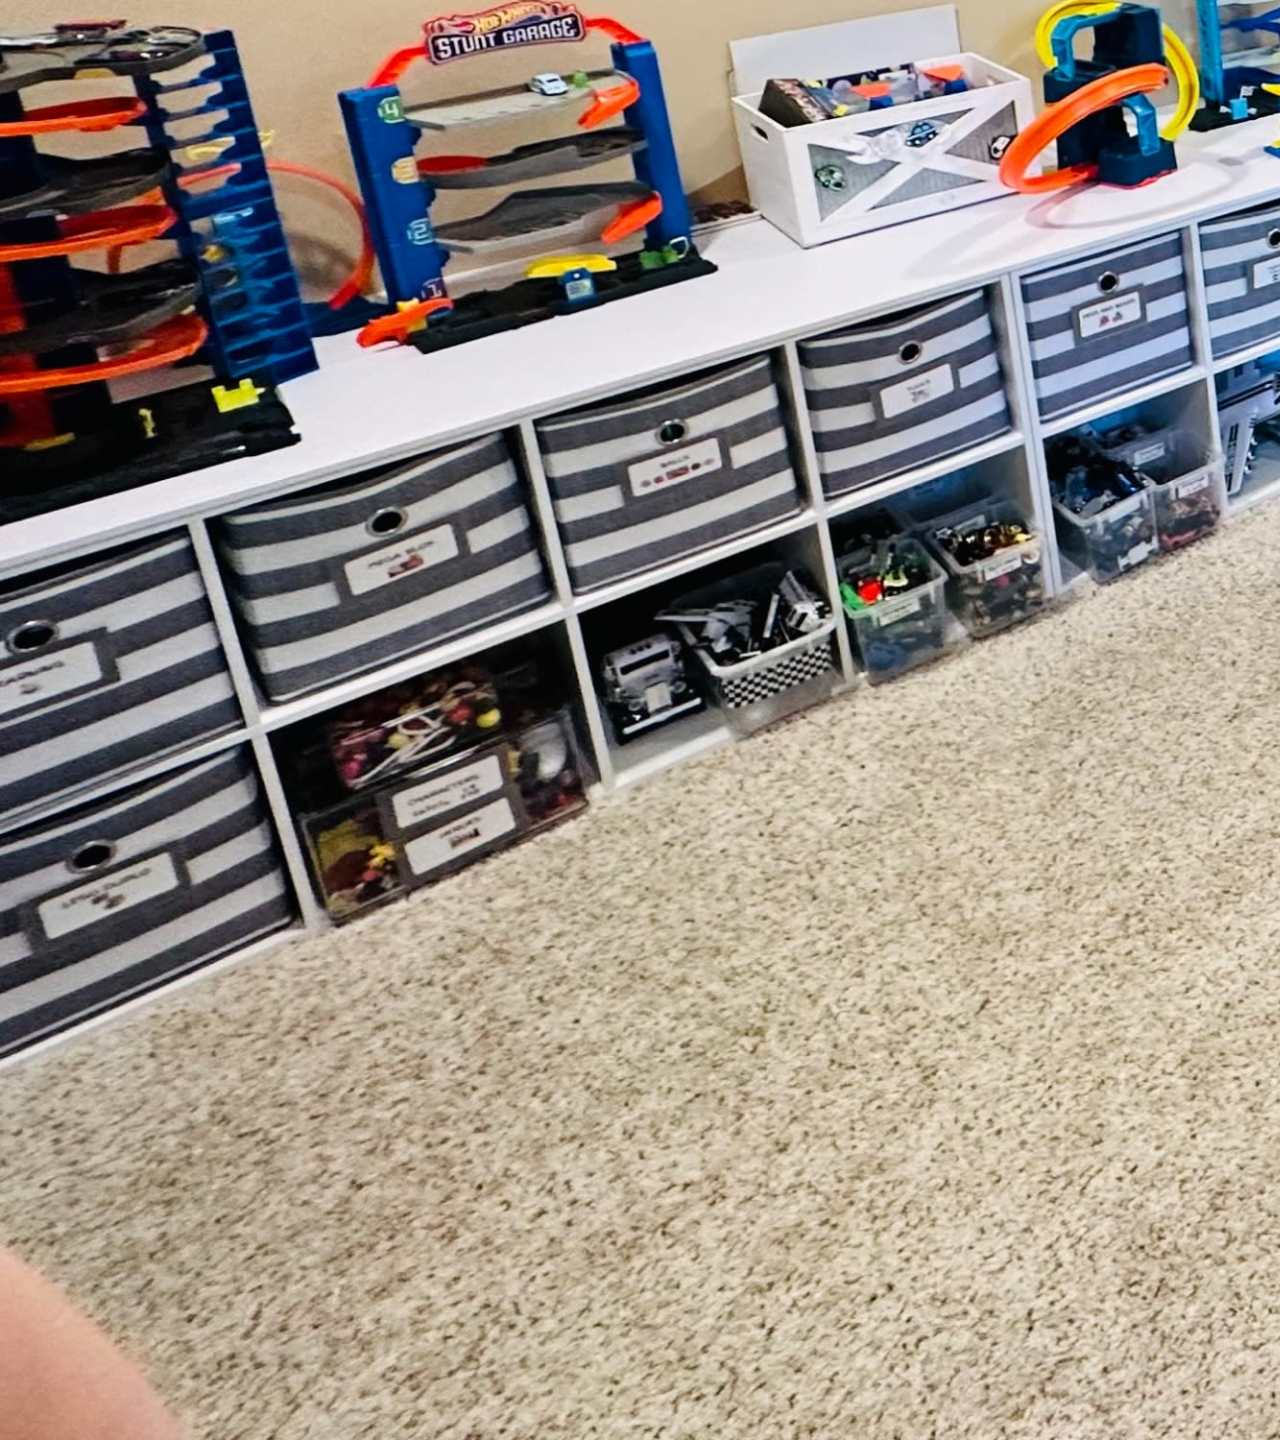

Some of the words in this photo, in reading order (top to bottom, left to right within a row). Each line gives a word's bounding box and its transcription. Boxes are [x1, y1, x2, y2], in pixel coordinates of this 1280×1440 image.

[435, 33, 497, 59] STUNT
[502, 17, 577, 44] GARAGE
[385, 102, 399, 118] 4
[414, 223, 428, 239] 2
